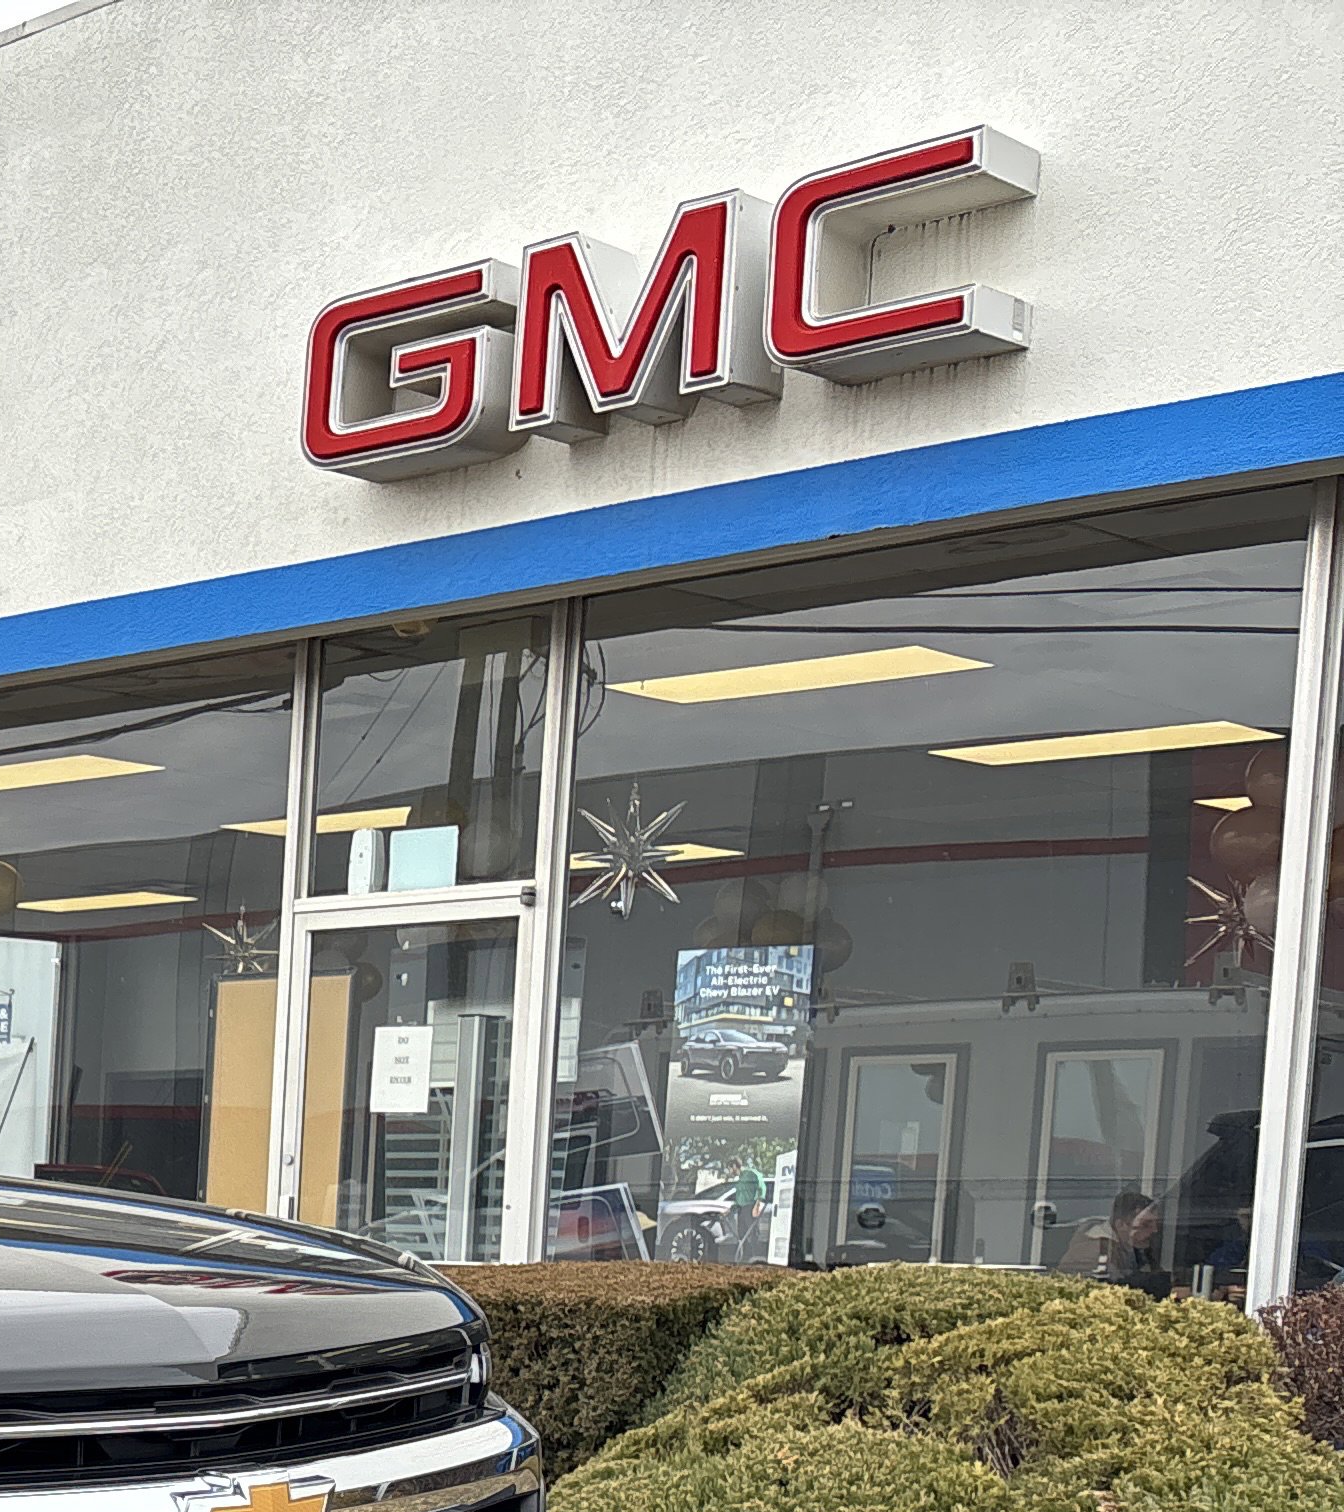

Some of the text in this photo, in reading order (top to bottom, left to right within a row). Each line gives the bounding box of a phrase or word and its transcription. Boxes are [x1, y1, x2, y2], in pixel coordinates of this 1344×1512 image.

[302, 125, 1002, 474] GMC
[706, 965, 723, 975] The
[700, 984, 780, 998] Chevy Blazer EV
[0, 1008, 8, 1019] &
